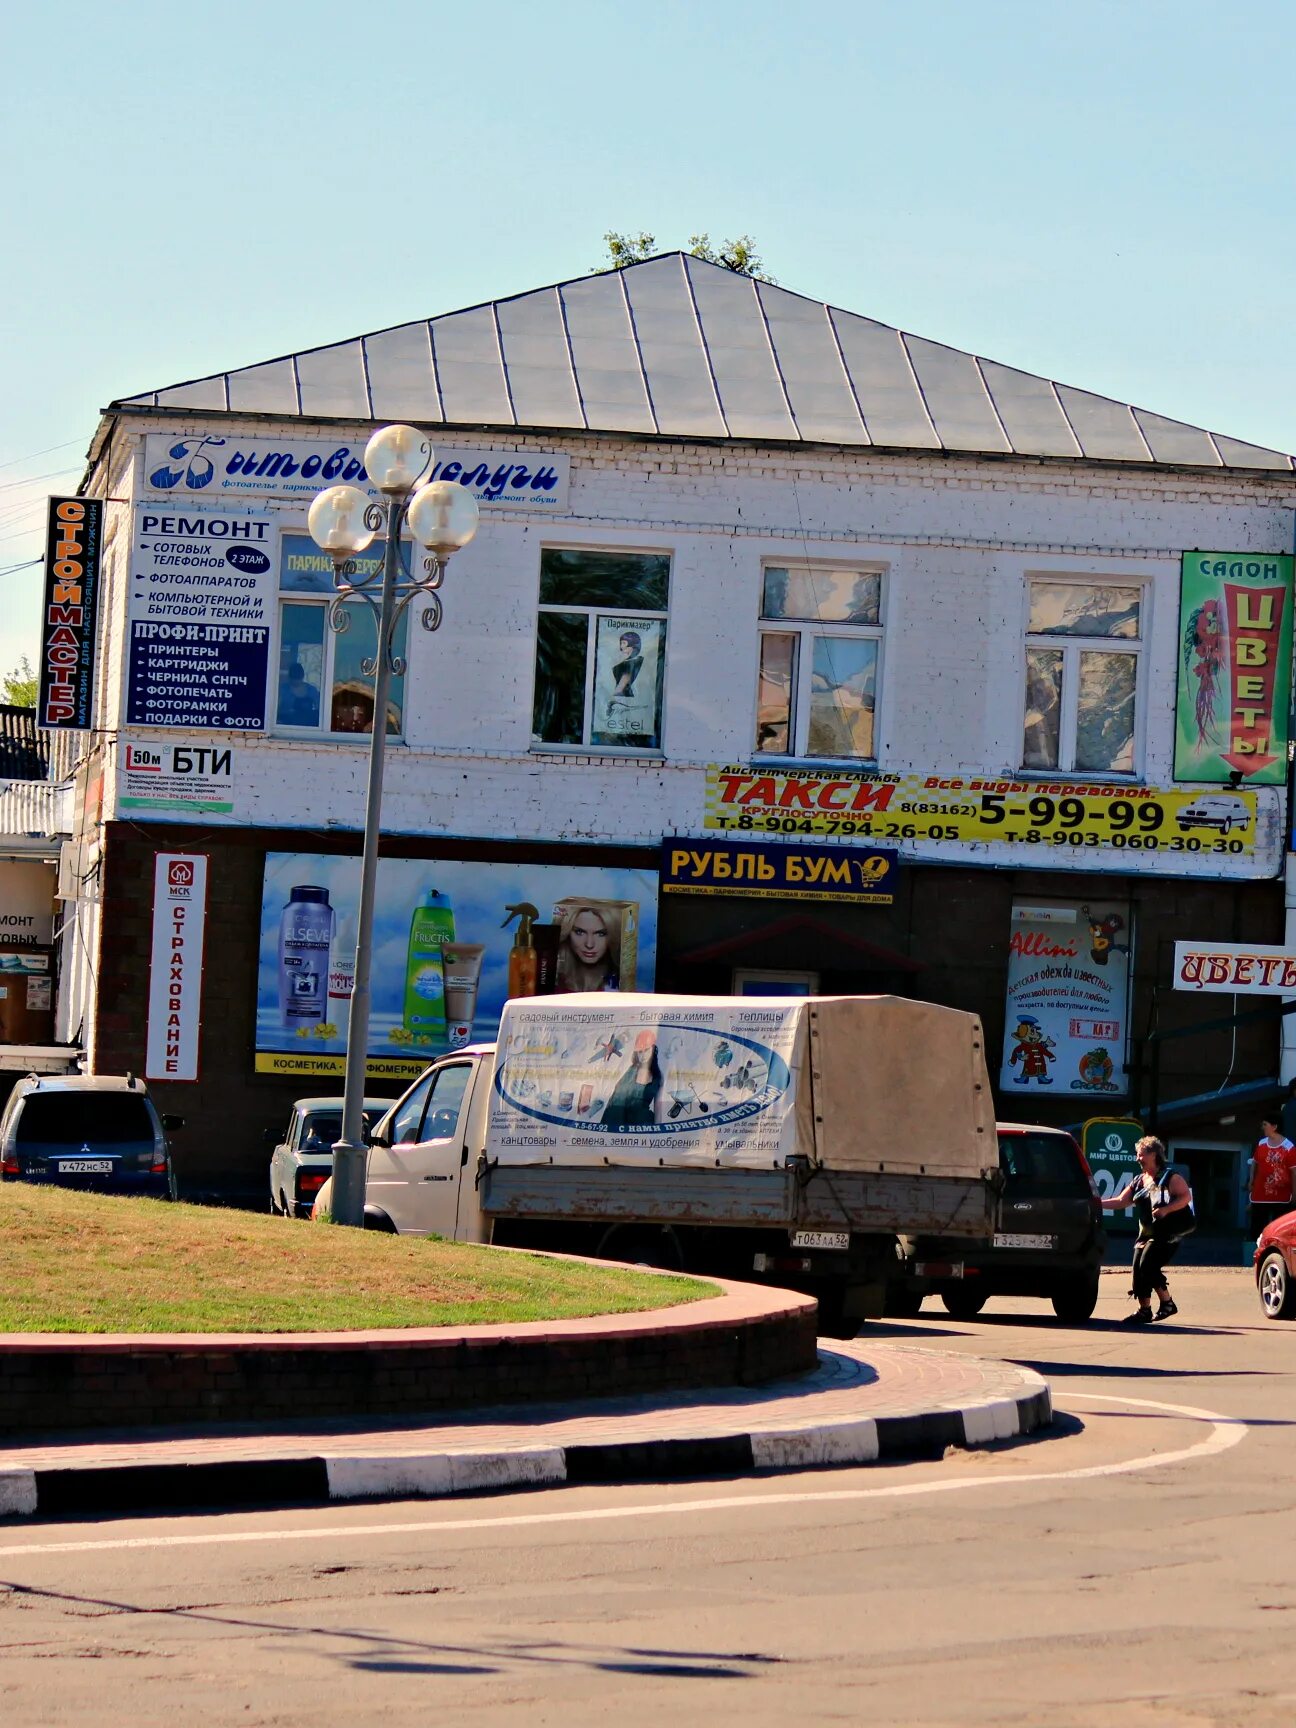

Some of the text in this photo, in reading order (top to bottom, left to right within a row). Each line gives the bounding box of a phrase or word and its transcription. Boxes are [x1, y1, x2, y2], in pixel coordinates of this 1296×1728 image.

[221, 479, 278, 490] фотоателье
[529, 496, 557, 504] обуви
[142, 515, 270, 539] РЕМОНТ
[153, 543, 211, 555] СОТОВЫХ
[153, 555, 225, 568] ТЕЛЕФОНОВ
[231, 554, 265, 565] 2 ЭТАЖ
[1200, 560, 1277, 580] САЛОН
[149, 573, 256, 588] ФОТОАППАРАТОВ
[148, 591, 263, 607] КОМПЬЮТЕРНОЙ И
[46, 501, 86, 724] СТРОЙМАСТЕР
[78, 504, 97, 725] МАГАЗИН ДЛЯ НАСТОЯЩИХ МУЖЧИН
[148, 604, 263, 619] БЫТОВОЙ ТЕХНИКИ
[134, 622, 266, 643] ПРОФИ-ПРИНТ
[148, 644, 219, 657] ПРИНТЕРЫ
[148, 658, 229, 672] КАРТРИДЖИ
[147, 672, 247, 686] ЧЕРНИЛА СНПЧ
[1232, 592, 1275, 755] ЦВЕТЫ
[146, 685, 233, 699] ФОТОПЕЧАТЬ
[145, 699, 228, 712] ФОТОРАМКИ
[145, 712, 262, 727] ПОДАРКИ С ФОТО
[607, 718, 644, 731] estel
[173, 747, 232, 776] БТИ
[720, 765, 901, 784] Диспетчерская служба
[718, 775, 895, 812] ТАКСИ
[923, 777, 1156, 800] Все виды перевозок.
[741, 806, 874, 822] КРУГЛОСУТОЧНО
[900, 794, 1164, 832] 8(83162) 5-99-99
[671, 850, 776, 880] РУБЛЬ
[785, 856, 852, 884] БУМ
[169, 886, 190, 896] МСК
[668, 887, 708, 895] КОСМЕТИКА
[828, 893, 856, 901] ТОВАРЫ
[856, 894, 871, 902] ДЛЯ
[1041, 963, 1073, 980] одежда
[1074, 970, 1113, 993] известных
[165, 906, 186, 1073] СТРАХОВАНИЕ
[519, 1011, 784, 1024] садовый инструмент бытовая химия теплицы
[273, 1059, 337, 1071] КОСМЕТИКА
[628, 1124, 662, 1133] нами
[664, 1117, 718, 1132] приятно
[719, 1104, 757, 1122] иметь
[501, 1136, 557, 1146] канцтовары
[571, 1137, 607, 1146] семена,
[610, 1138, 639, 1146] земля
[649, 1137, 701, 1149] удобрения
[715, 1140, 780, 1150] умывальники
[1089, 1152, 1107, 1160] МИР
